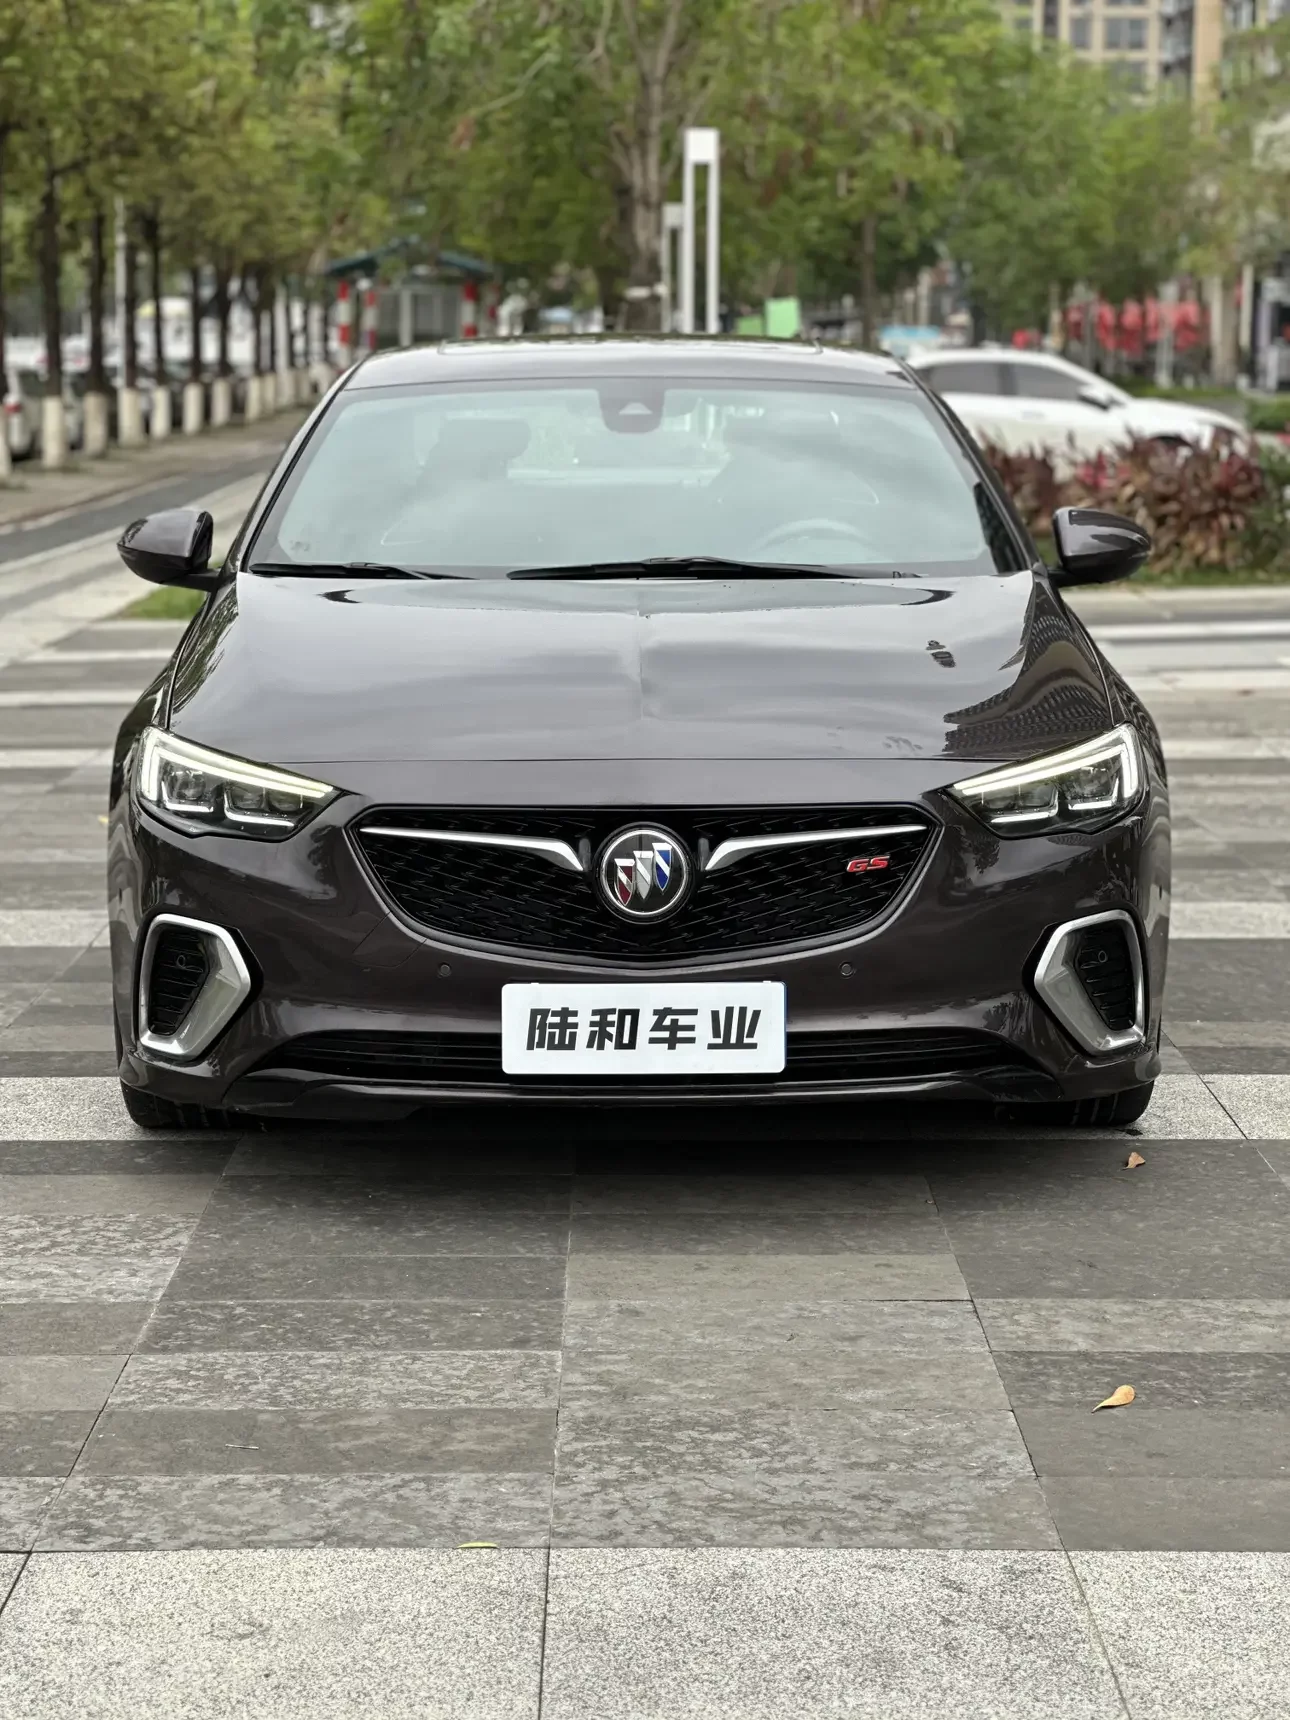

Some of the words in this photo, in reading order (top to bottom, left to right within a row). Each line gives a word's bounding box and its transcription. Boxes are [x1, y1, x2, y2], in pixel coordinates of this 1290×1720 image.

[846, 855, 890, 873] GS
[526, 1006, 762, 1051] 陆和车业
